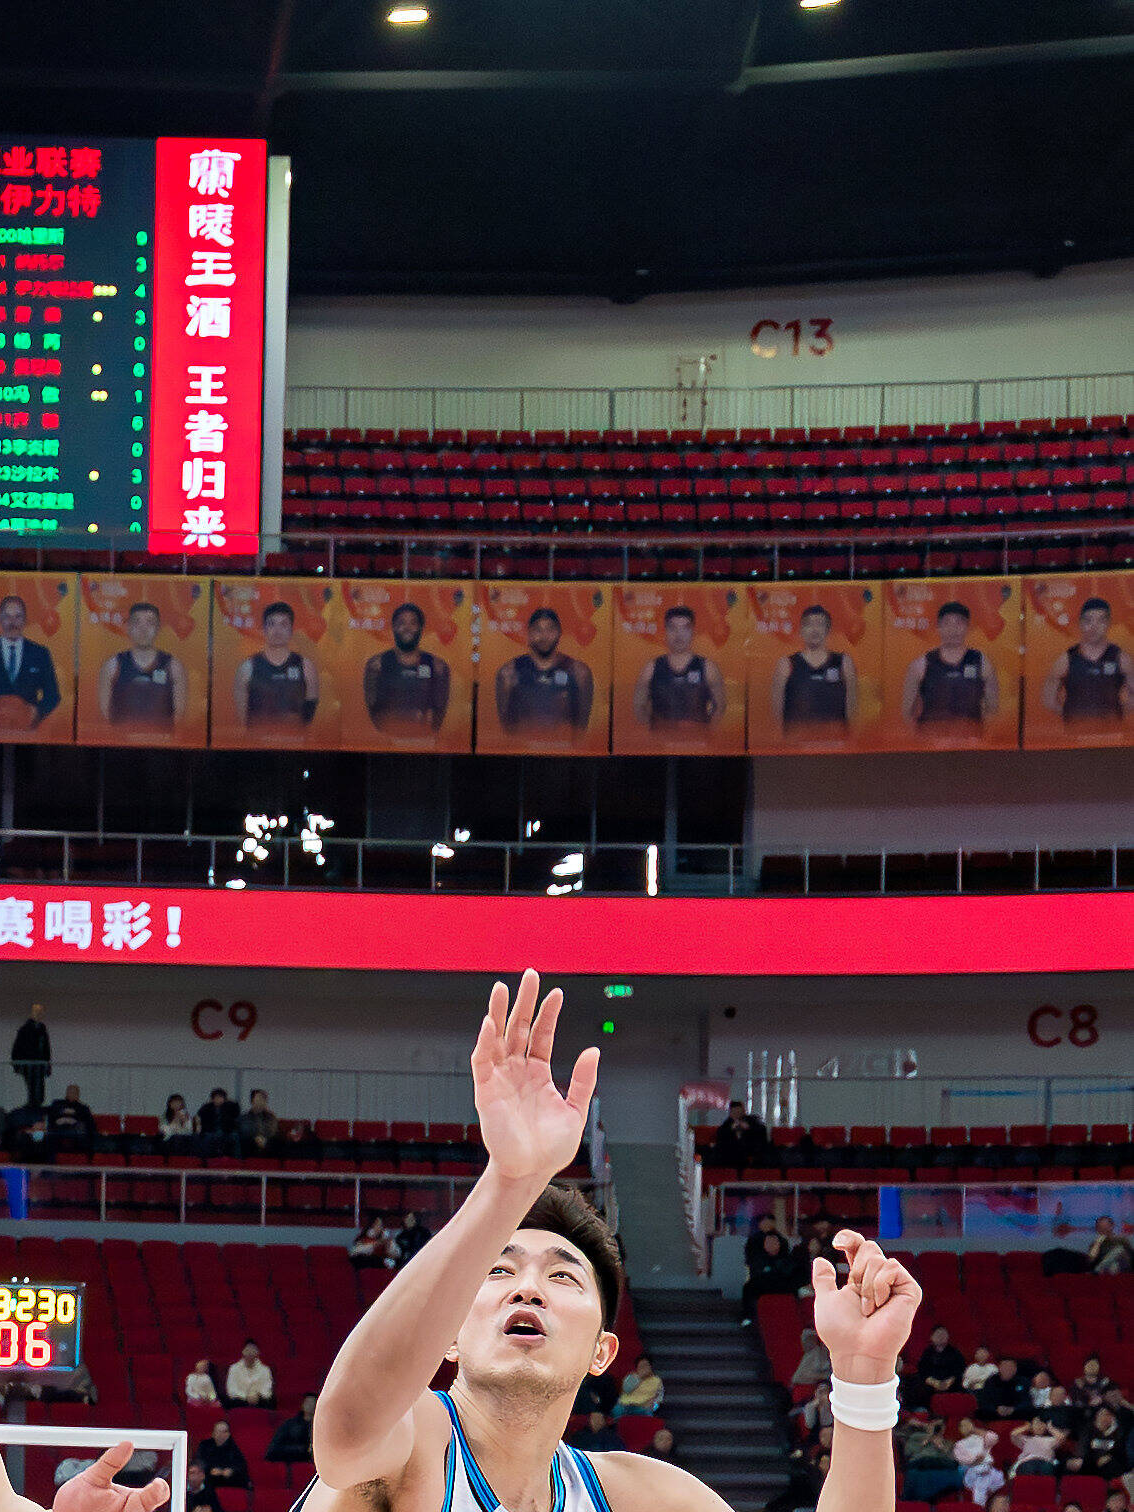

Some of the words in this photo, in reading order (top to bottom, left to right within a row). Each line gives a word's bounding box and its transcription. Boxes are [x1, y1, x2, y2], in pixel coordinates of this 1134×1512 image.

[750, 318, 834, 358] C13
[181, 365, 229, 548] 王者归来
[191, 999, 258, 1041] C9
[1027, 1004, 1099, 1048] C8
